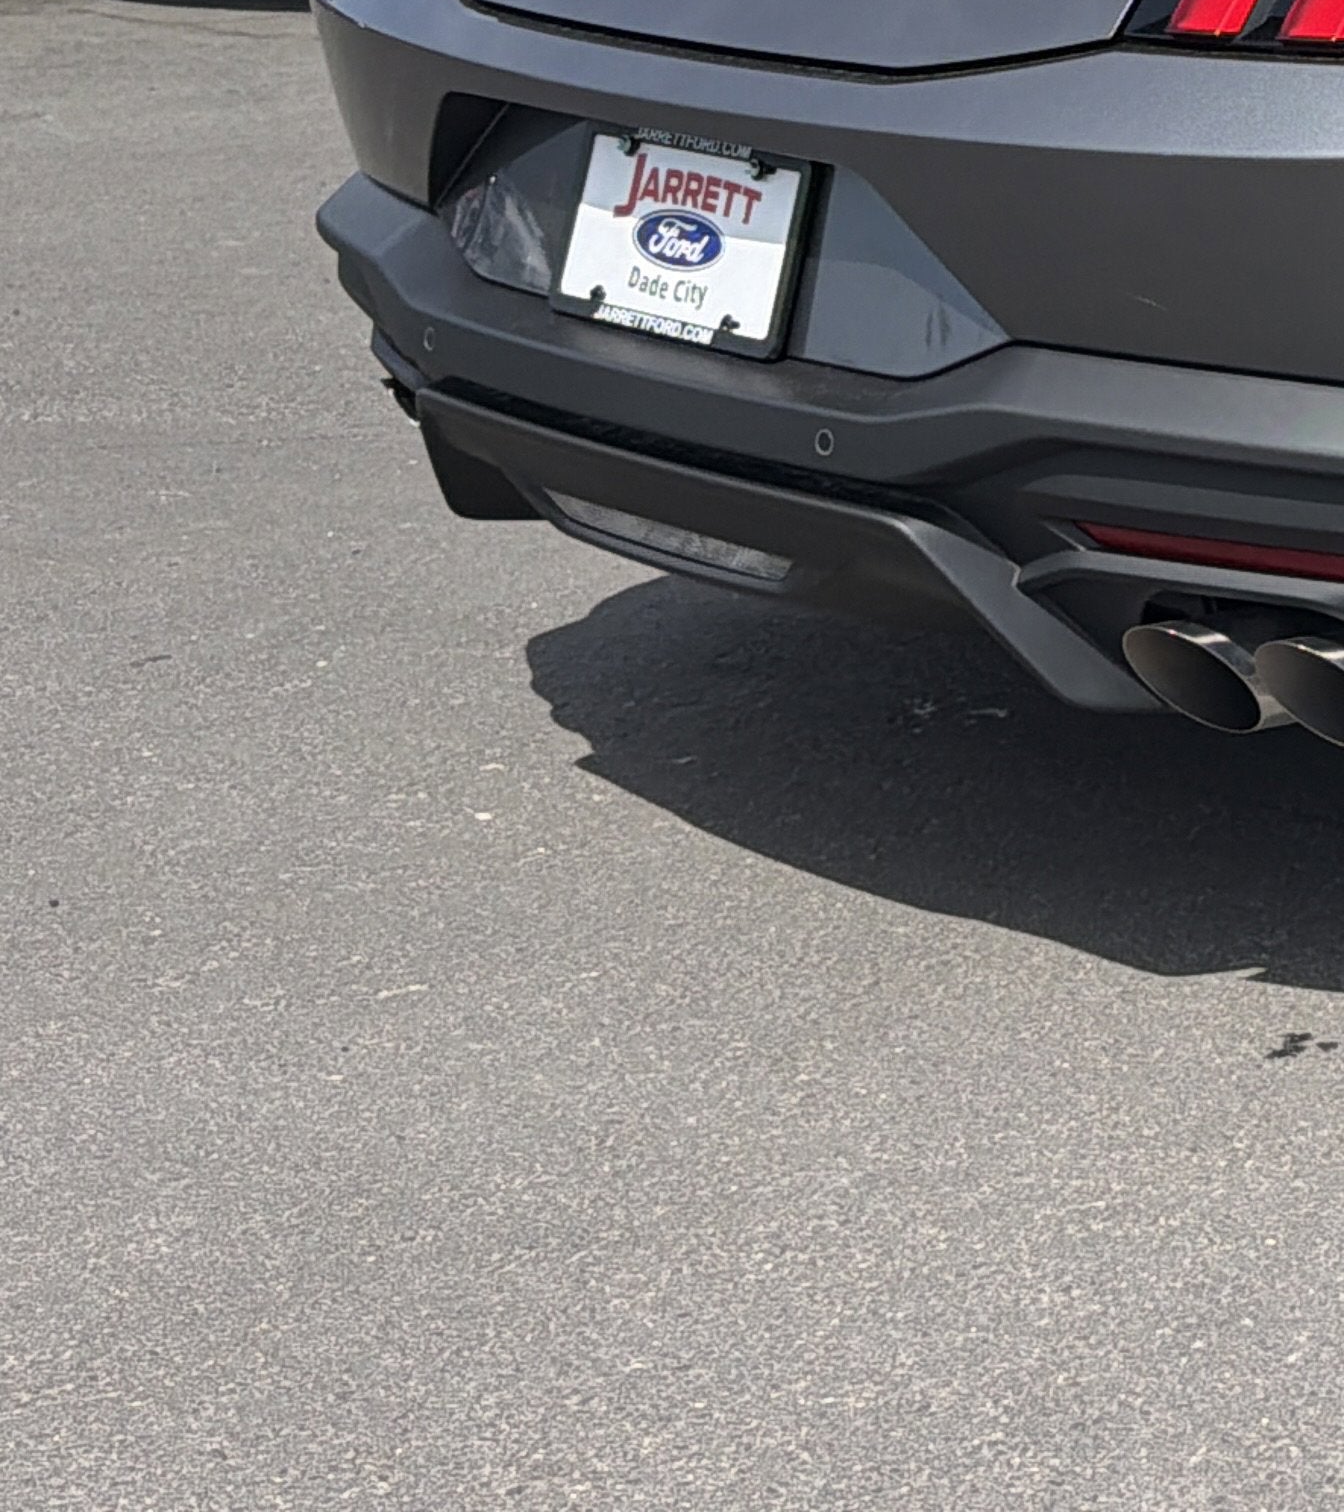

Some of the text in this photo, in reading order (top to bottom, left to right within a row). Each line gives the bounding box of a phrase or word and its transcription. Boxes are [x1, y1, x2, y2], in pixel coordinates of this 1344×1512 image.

[634, 127, 754, 159] JARRETTFORD.COM
[613, 153, 763, 225] JARRETT
[649, 217, 710, 263] Ford
[627, 265, 709, 310] Dade City
[592, 304, 715, 345] JARRETTFORD.COM
